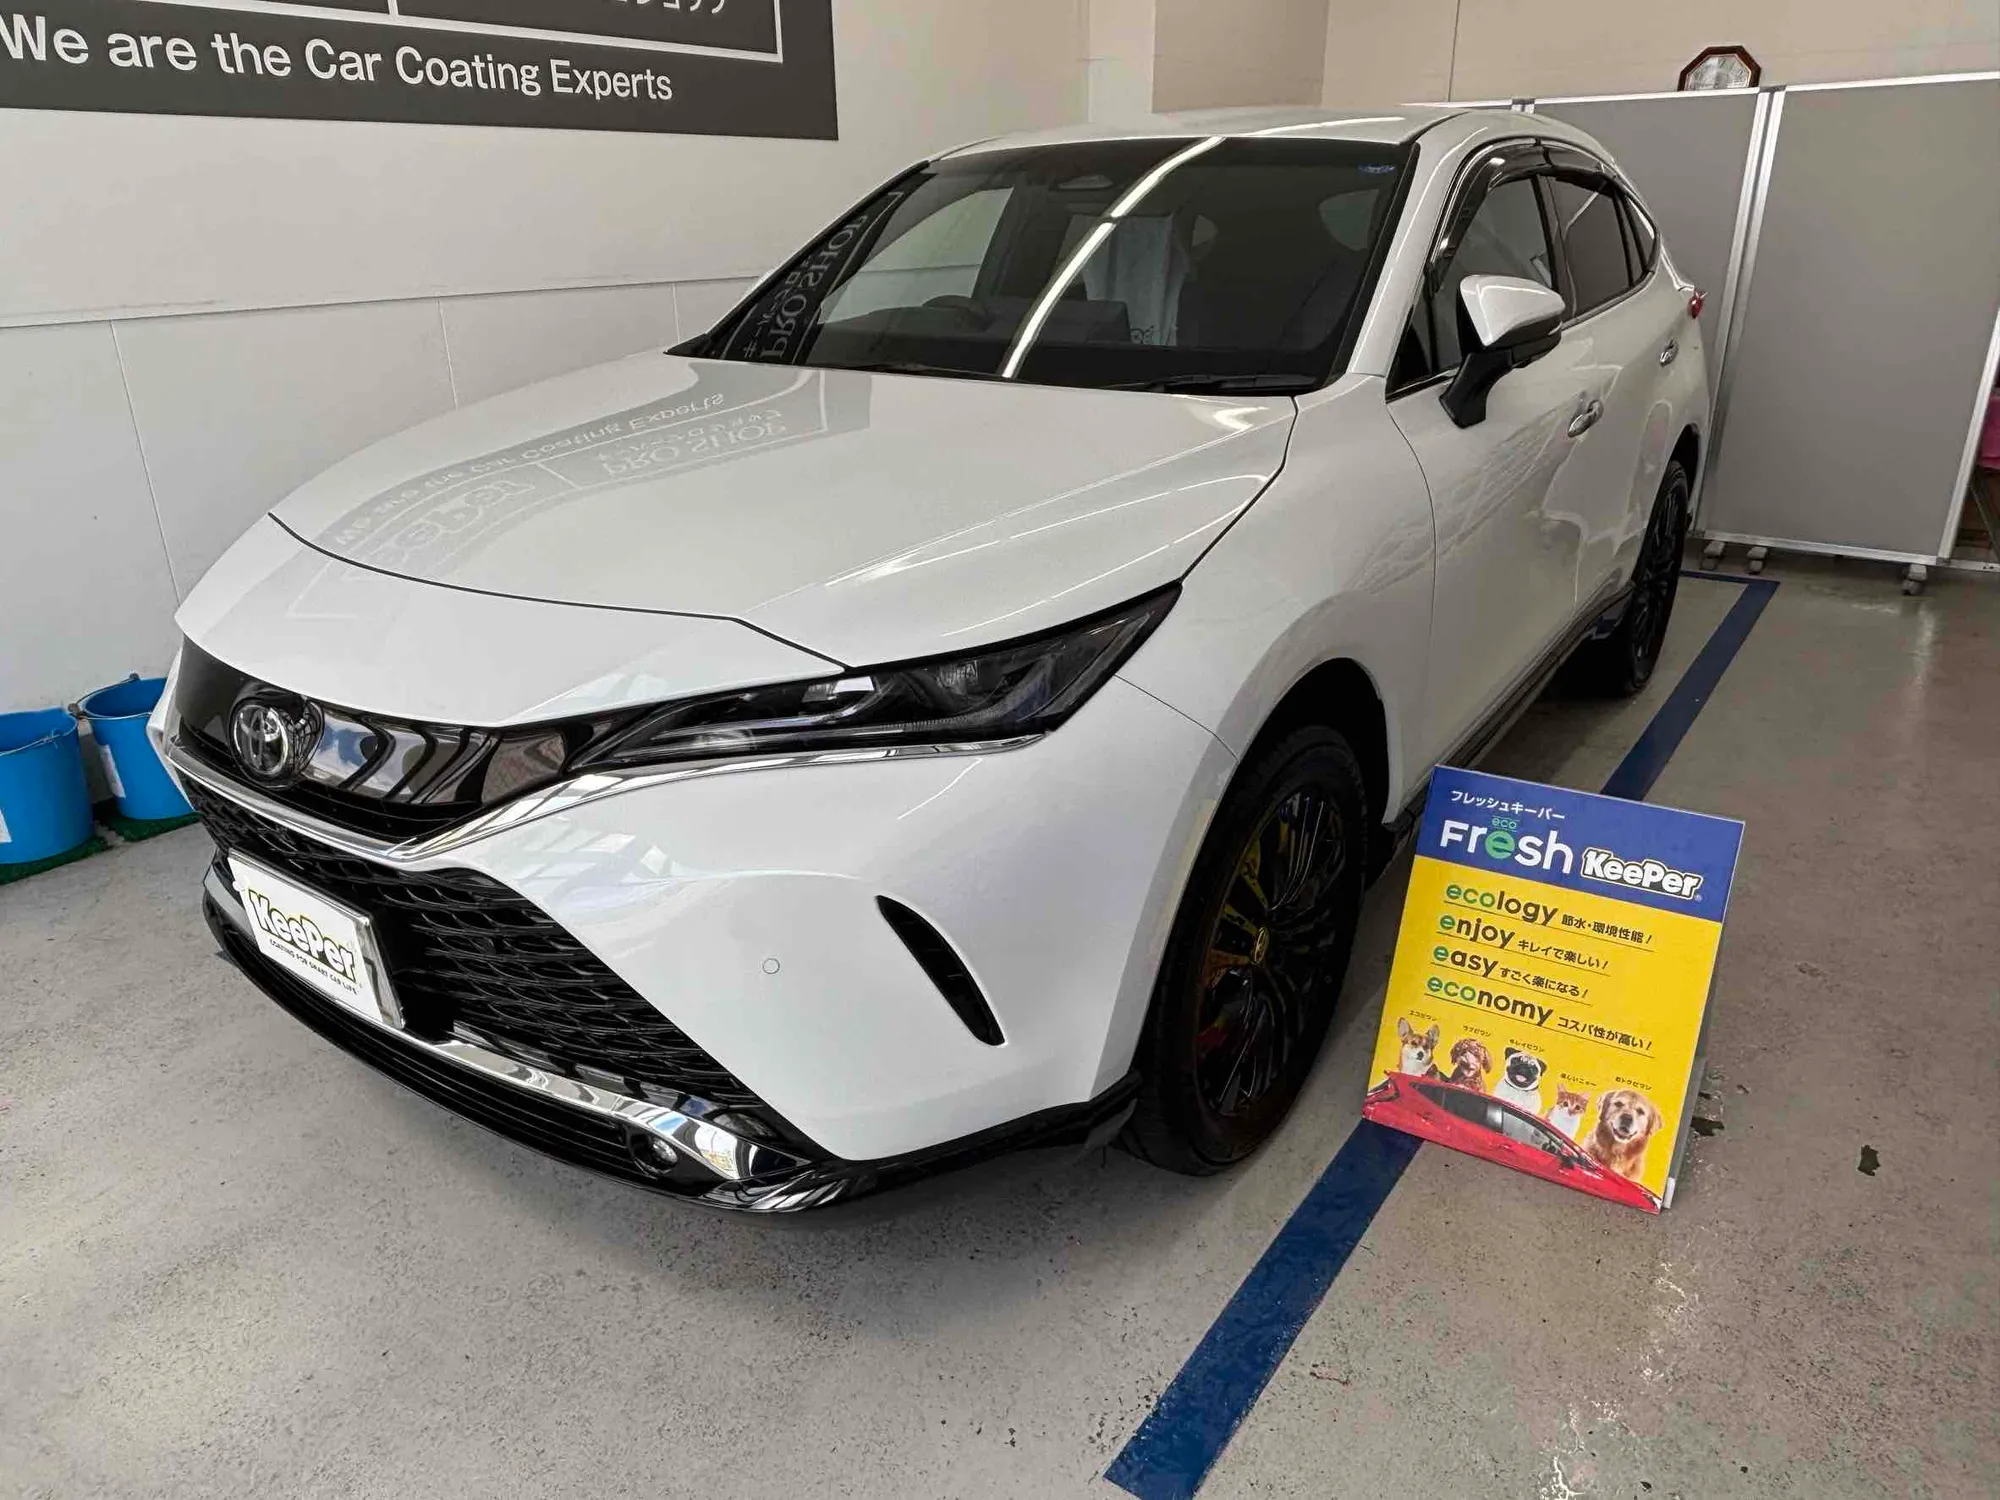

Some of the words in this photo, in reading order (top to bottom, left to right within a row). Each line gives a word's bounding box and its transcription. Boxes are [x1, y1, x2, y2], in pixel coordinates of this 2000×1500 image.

[0, 13, 89, 65] We
[107, 33, 197, 71] are
[211, 33, 291, 77] the
[305, 39, 382, 83] Car
[396, 46, 541, 96] Coating
[550, 59, 673, 101] Experts
[1491, 817, 1517, 829] eco
[1440, 819, 1574, 874] Fresh
[1582, 847, 1702, 899] KeePer
[1446, 884, 1558, 926] ecology
[248, 889, 356, 983] KeePer
[1440, 915, 1515, 949] enjoy
[1433, 946, 1498, 978] easy
[1427, 977, 1553, 1026] economy
